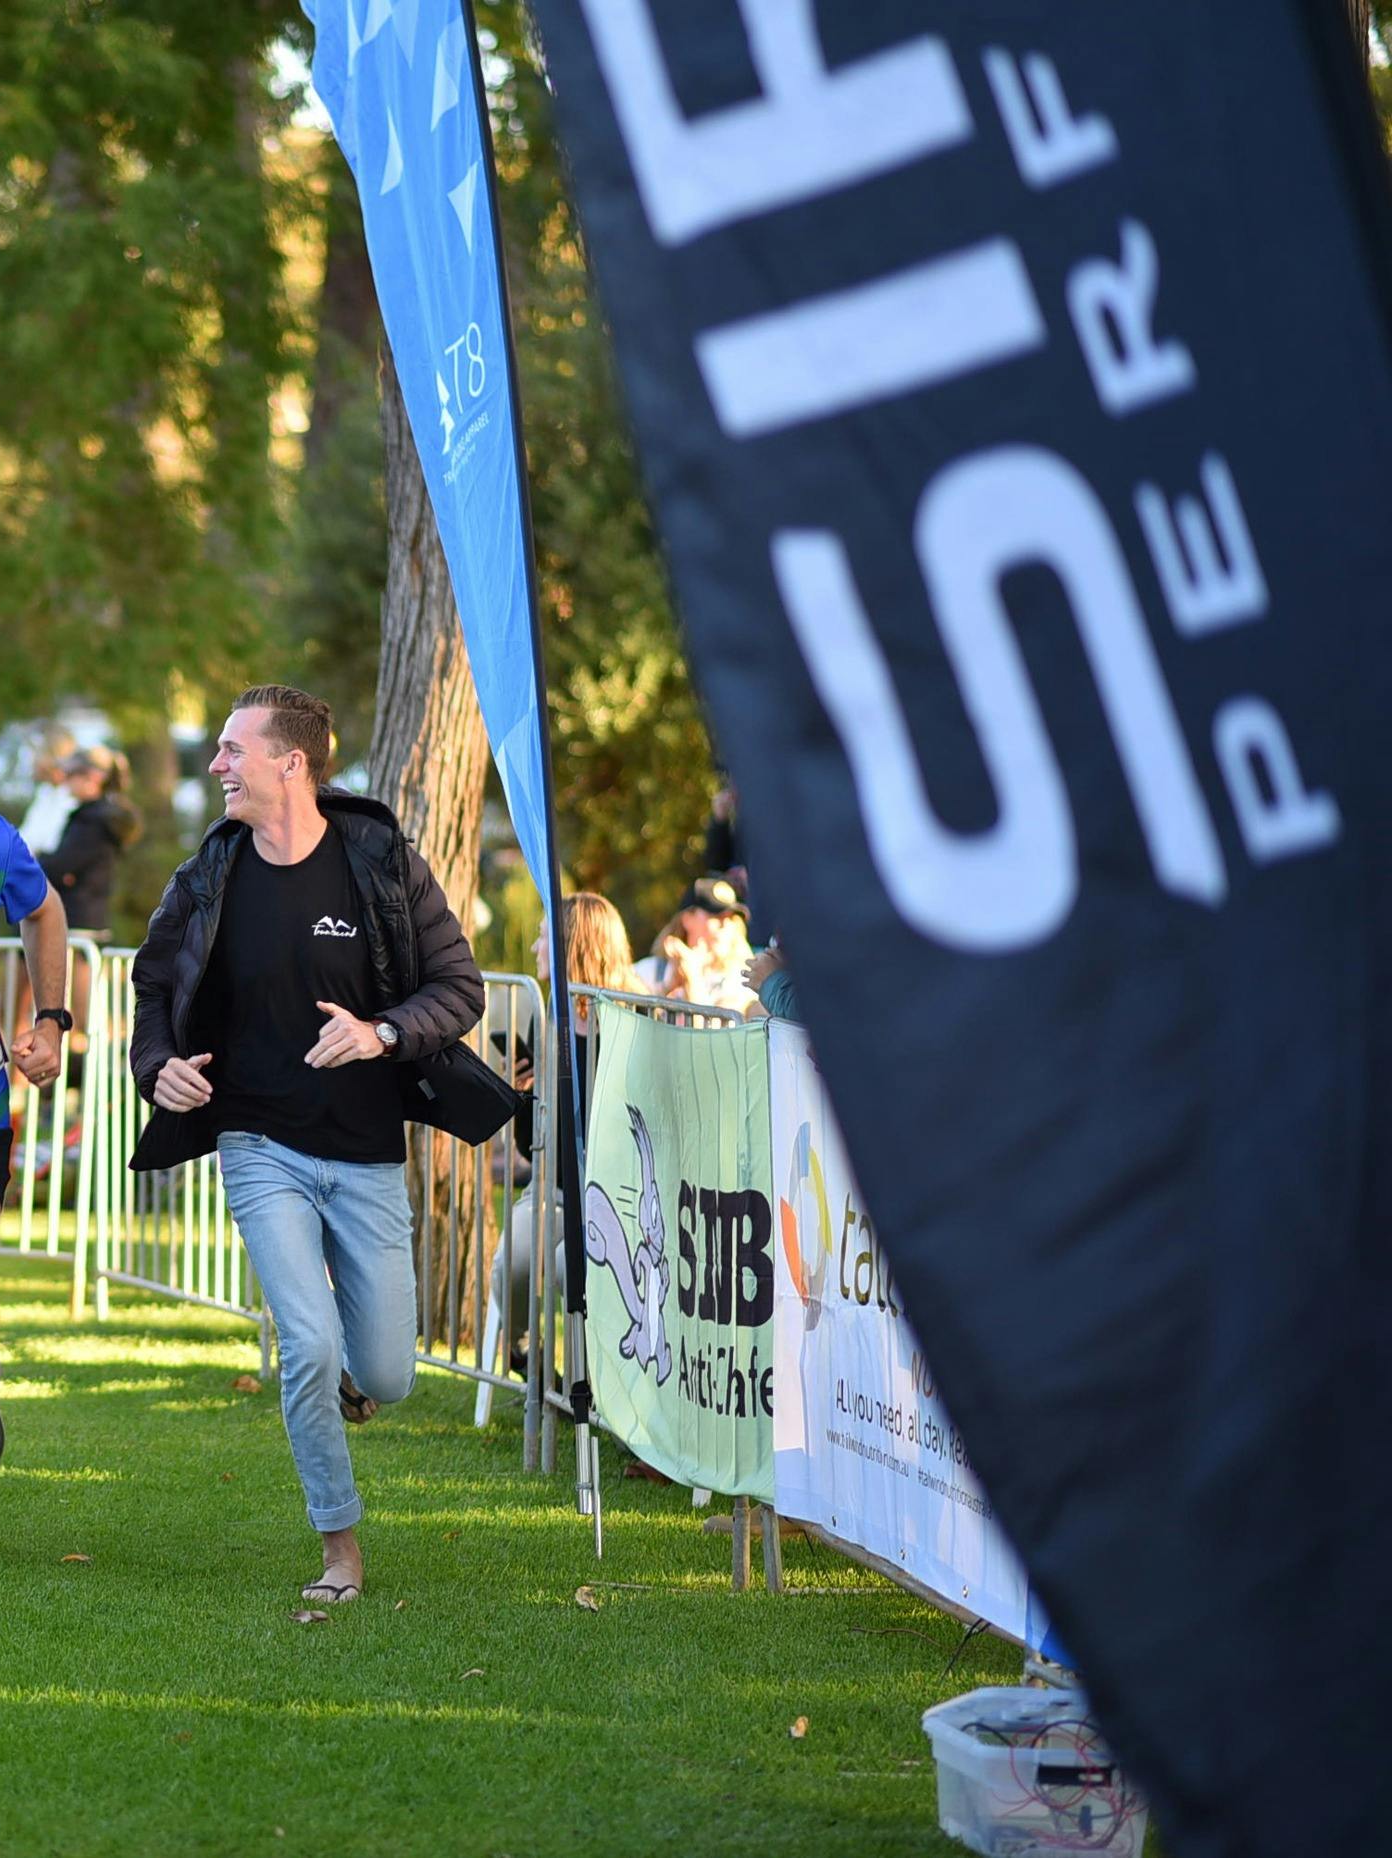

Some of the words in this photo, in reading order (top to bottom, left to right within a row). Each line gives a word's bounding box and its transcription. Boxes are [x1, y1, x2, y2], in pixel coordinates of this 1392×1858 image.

[444, 322, 486, 414] T8
[982, 45, 1343, 866] PERF
[852, 1391, 873, 1423] you
[907, 1409, 922, 1446] all
